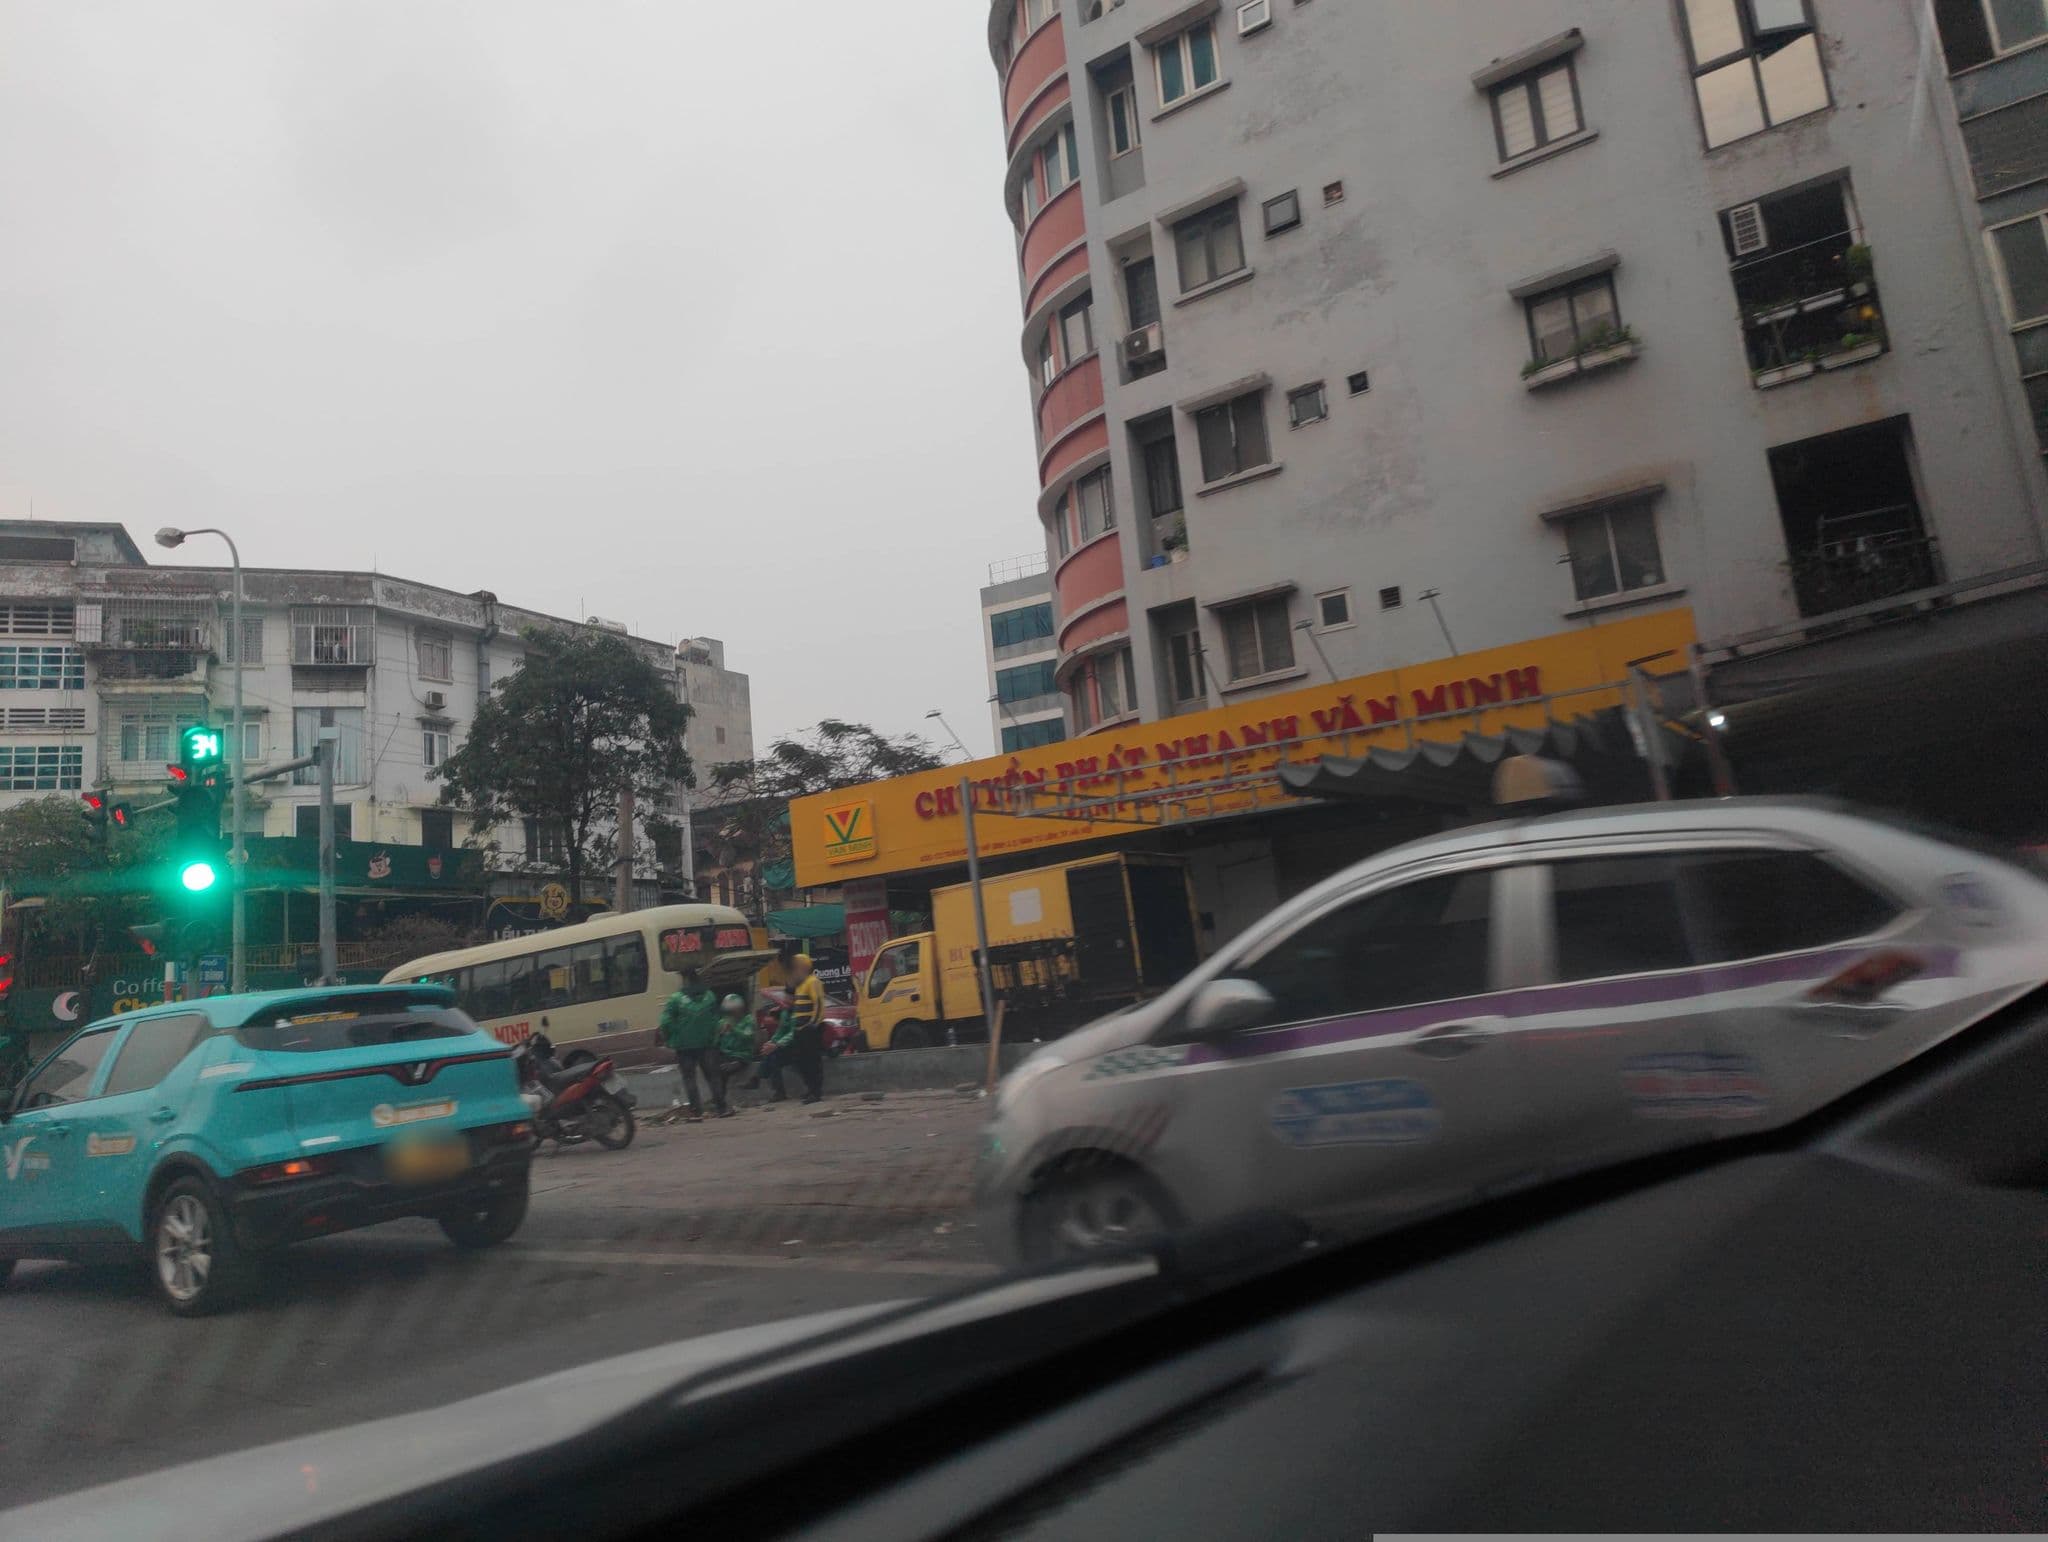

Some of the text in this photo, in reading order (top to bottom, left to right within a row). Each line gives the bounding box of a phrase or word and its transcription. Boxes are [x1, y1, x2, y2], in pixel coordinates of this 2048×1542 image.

[1054, 743, 1147, 793] PHÁT
[1154, 714, 1301, 773] NHANH
[1310, 694, 1401, 743] VĂN
[1411, 664, 1543, 718] MINH
[113, 976, 181, 996] Coffe
[494, 1021, 530, 1045] MINH
